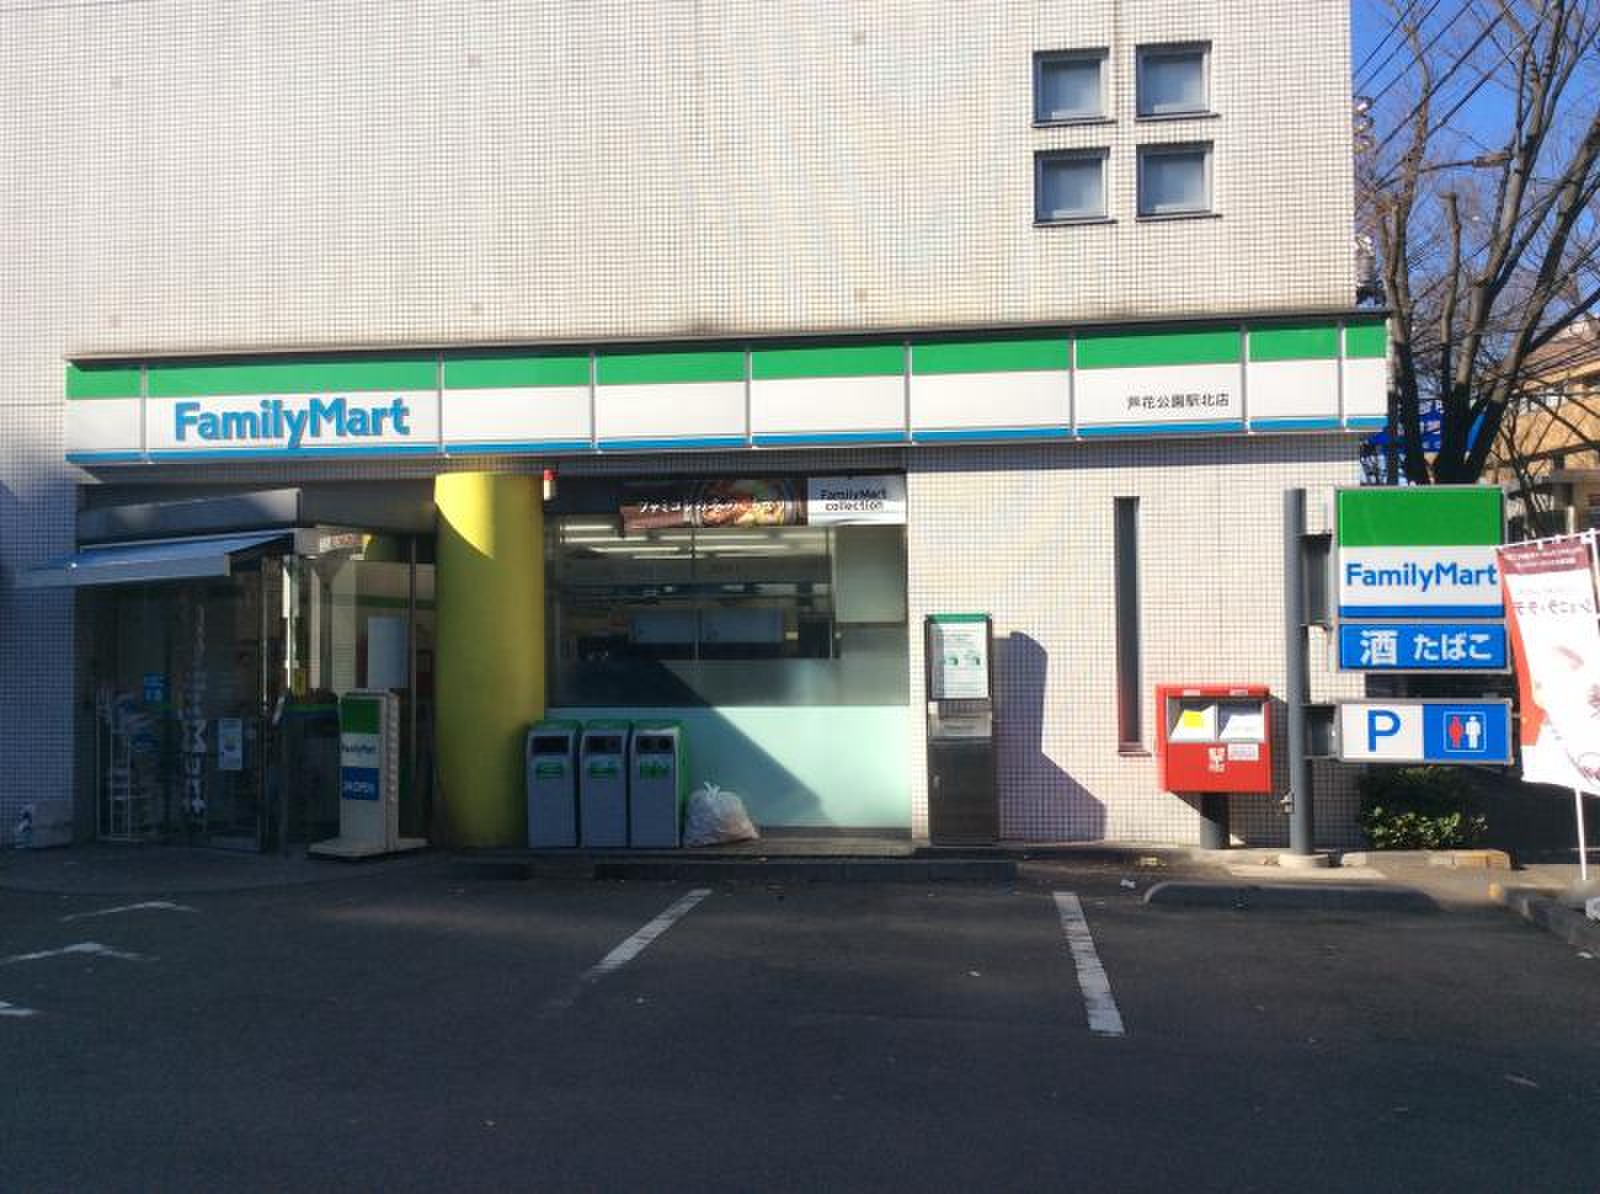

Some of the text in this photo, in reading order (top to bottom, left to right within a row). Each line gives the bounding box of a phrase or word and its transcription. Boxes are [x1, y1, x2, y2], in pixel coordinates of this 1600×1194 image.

[174, 397, 410, 448] FamilyMart
[1345, 562, 1499, 592] FamilyMart
[1360, 629, 1493, 666] 酒 たばこ
[1367, 709, 1401, 753] P
